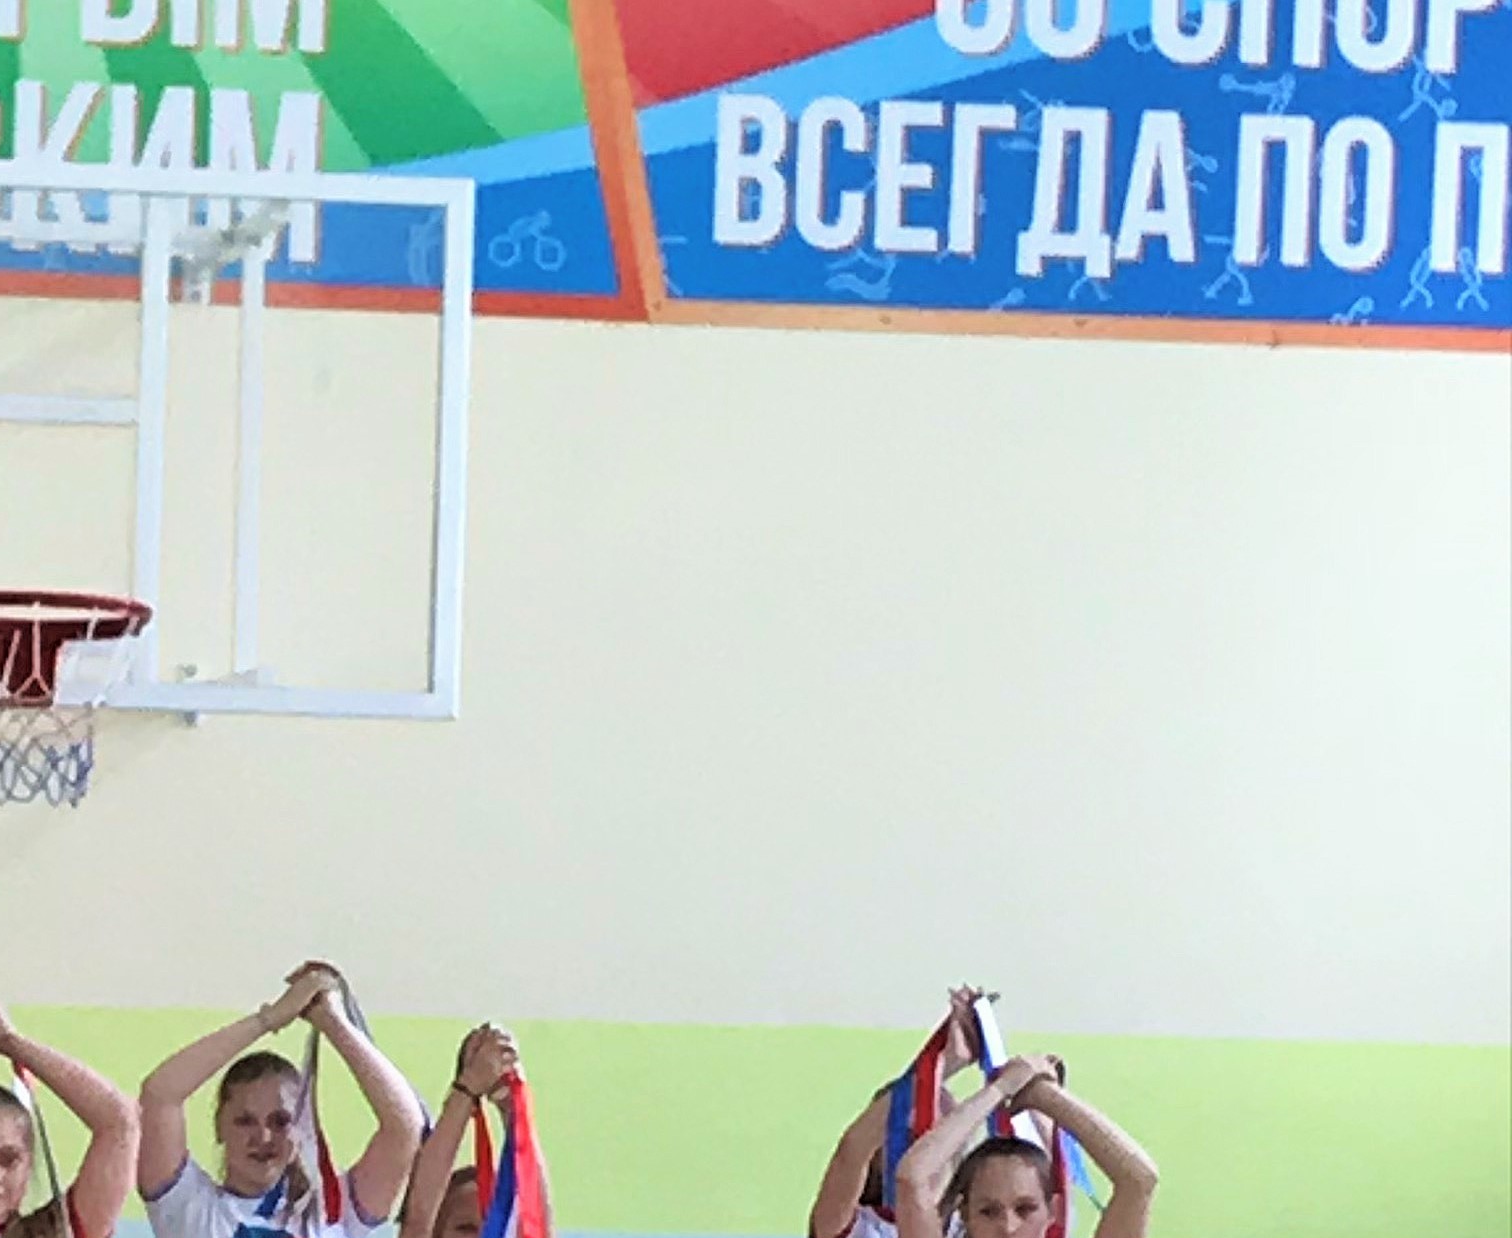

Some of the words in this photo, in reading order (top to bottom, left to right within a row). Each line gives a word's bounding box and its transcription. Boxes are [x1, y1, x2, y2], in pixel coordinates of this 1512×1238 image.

[712, 93, 1198, 280] ВСЕГДА
[1233, 113, 1398, 274] ПО
[1428, 121, 1510, 273] П
